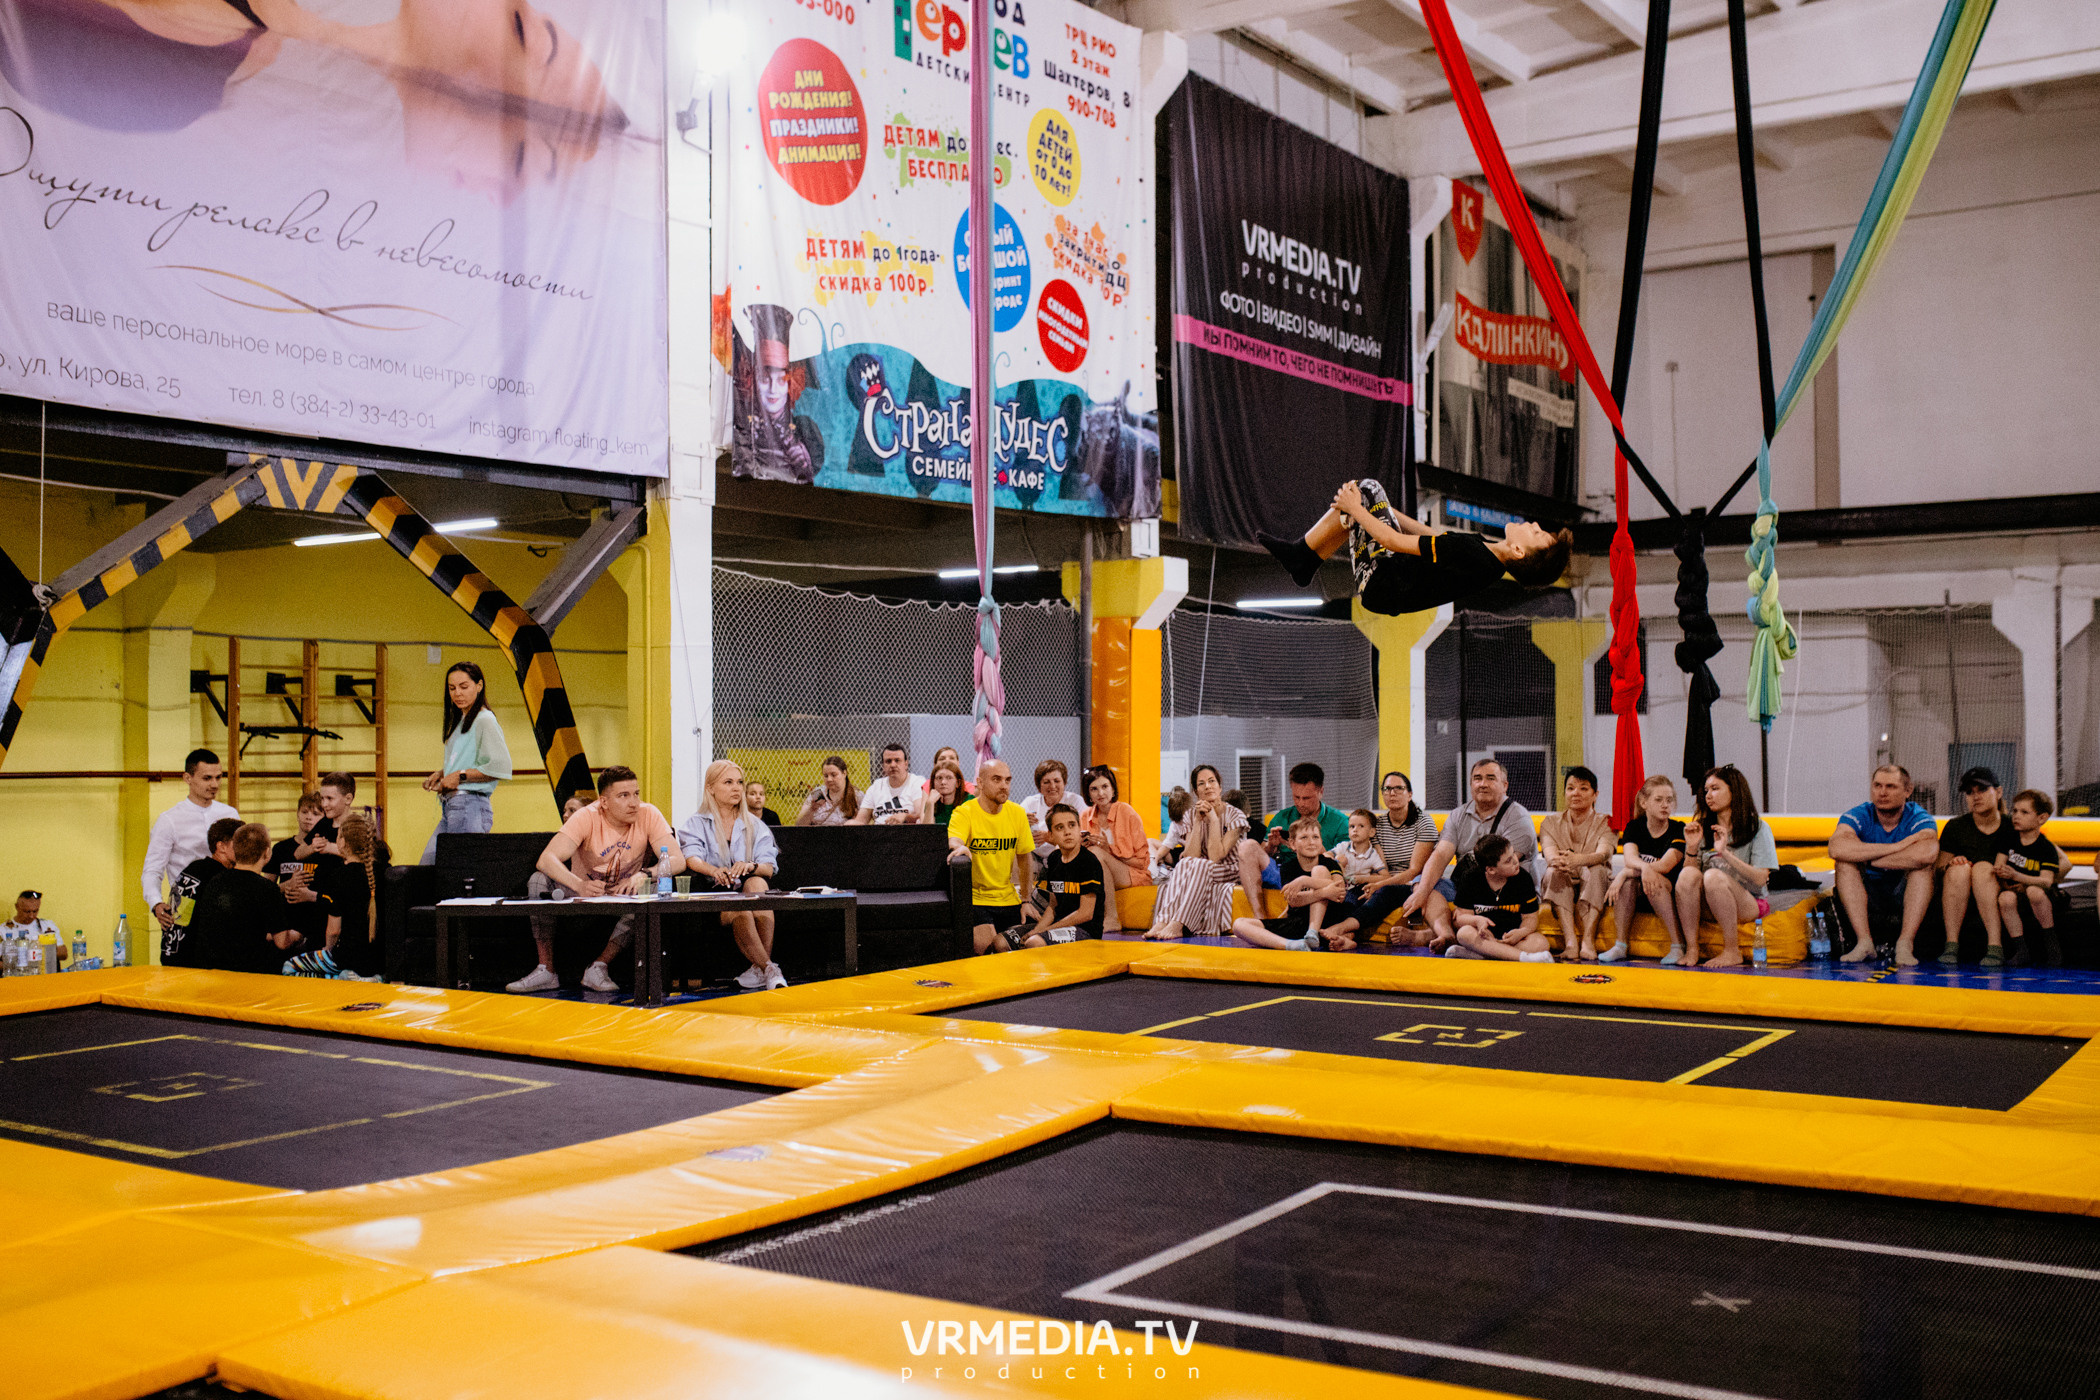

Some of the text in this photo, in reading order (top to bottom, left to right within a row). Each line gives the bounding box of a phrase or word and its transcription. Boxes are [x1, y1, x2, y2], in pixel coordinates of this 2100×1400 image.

[1065, 23, 1116, 58] ТРЦ РИО
[1071, 49, 1111, 78] 2 этаж
[794, 69, 824, 89] ДНИ
[916, 51, 1030, 107] ДЕТСКИ ЕНТР
[768, 90, 853, 111] РОЖДЕНИЯ!
[1067, 94, 1116, 128] 900-708
[1123, 91, 1132, 109] 8
[769, 116, 859, 138] ПРАЗДНИКИ!
[884, 124, 940, 149] ДЕТЯМ
[947, 136, 967, 153] до
[778, 142, 861, 165] АНИМАЦИЯ!
[1035, 164, 1047, 181] 10
[1461, 194, 1475, 232] К
[806, 237, 866, 261] ДЕТЯМ
[873, 248, 890, 263] до
[1241, 218, 1361, 296] VRMEDIA.TV
[819, 275, 882, 294] скидка
[1241, 261, 1362, 316] production
[47, 301, 536, 398] ваше персональное море в самом центре города
[18, 355, 51, 378] ул.
[156, 375, 182, 399] 25
[228, 385, 266, 407] тел.
[272, 388, 285, 409] 8
[290, 390, 354, 419] (384-2)
[359, 403, 436, 430] 33-43-01
[554, 426, 649, 457] floating_kem
[1008, 467, 1045, 491] КАФЕ
